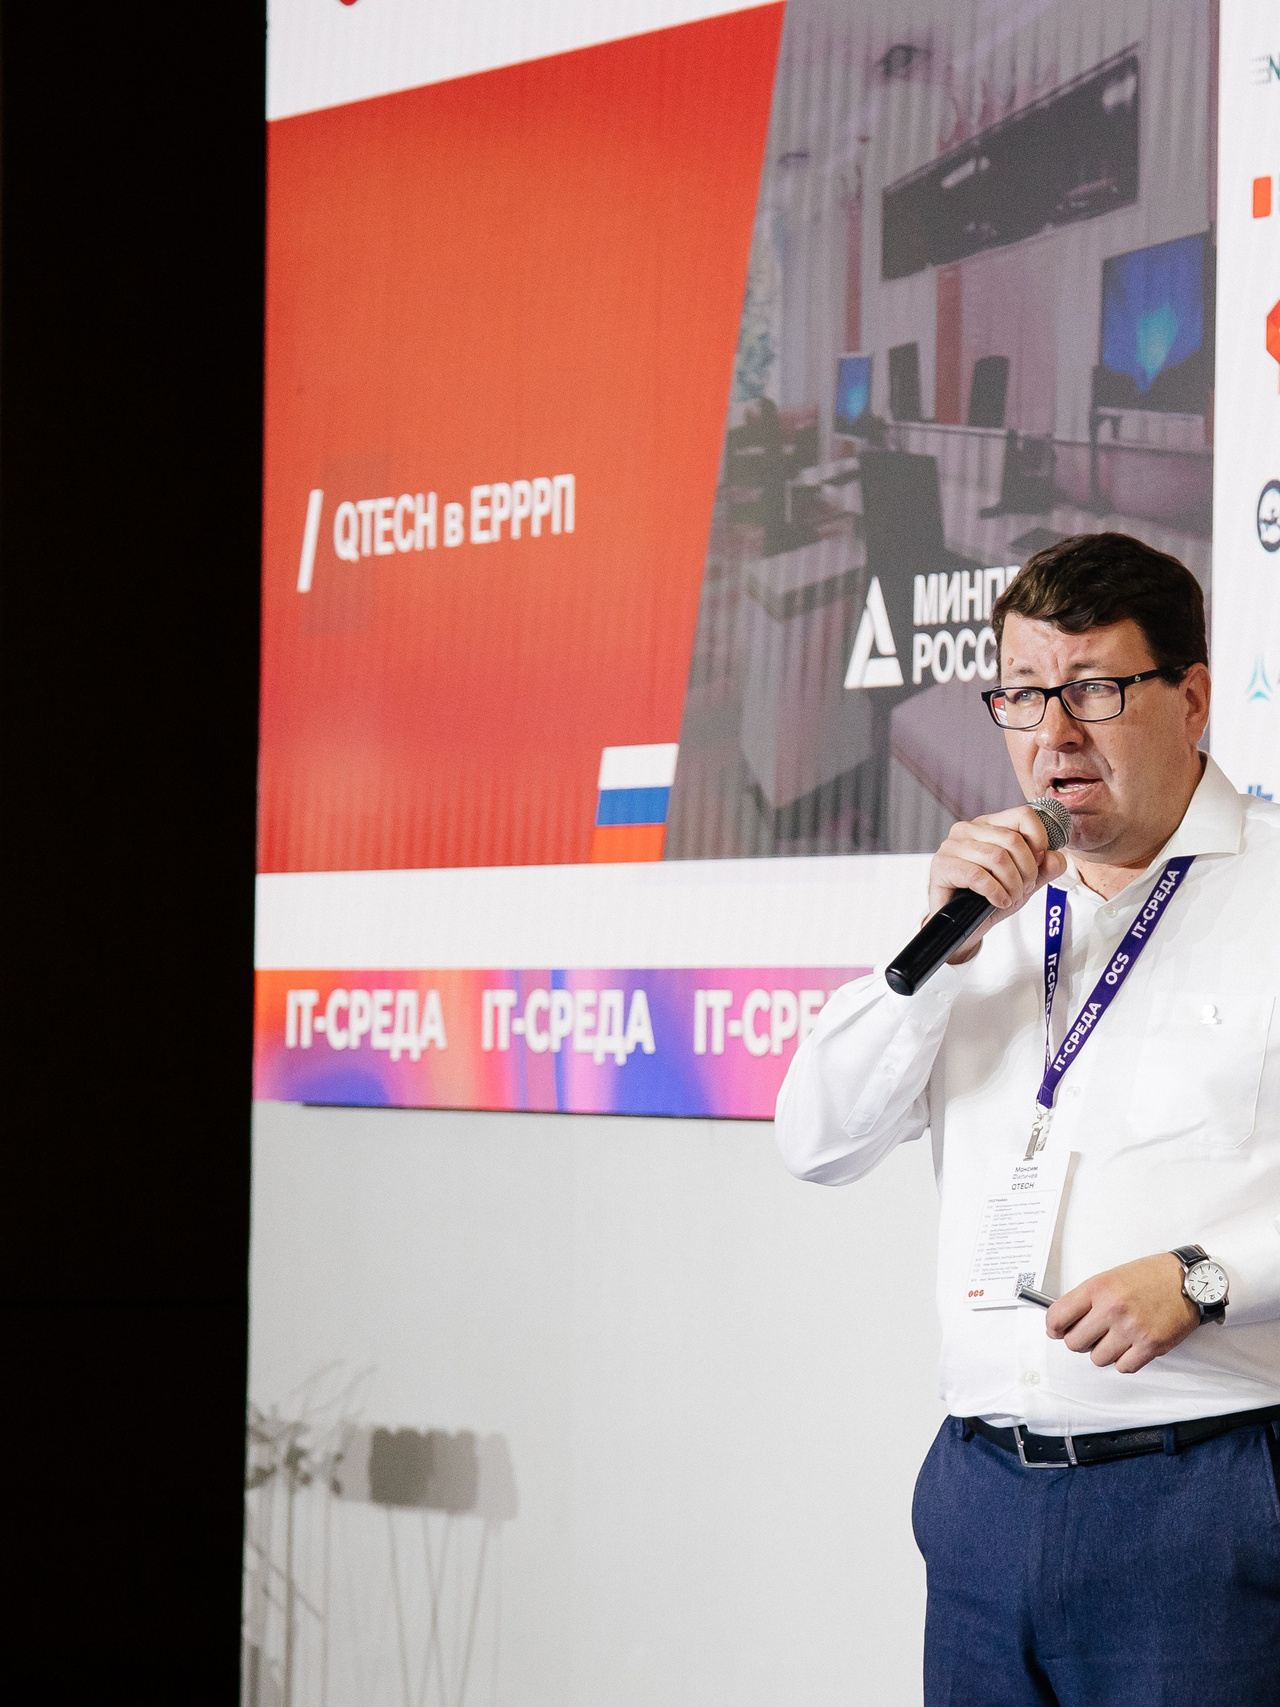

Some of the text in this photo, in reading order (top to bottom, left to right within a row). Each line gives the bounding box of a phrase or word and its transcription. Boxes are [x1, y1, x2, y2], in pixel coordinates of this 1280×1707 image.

[333, 491, 438, 563] QTECH
[470, 473, 576, 545] ЕРРРП
[1049, 905, 1062, 937] OCS
[1131, 869, 1180, 939] IT-СРЕДА
[1104, 952, 1130, 985] OCS
[285, 988, 839, 1066] IT-СРЕДА IT-СРЕДА IT-СРЕ
[1052, 1001, 1102, 1072] IT-СРЕДА
